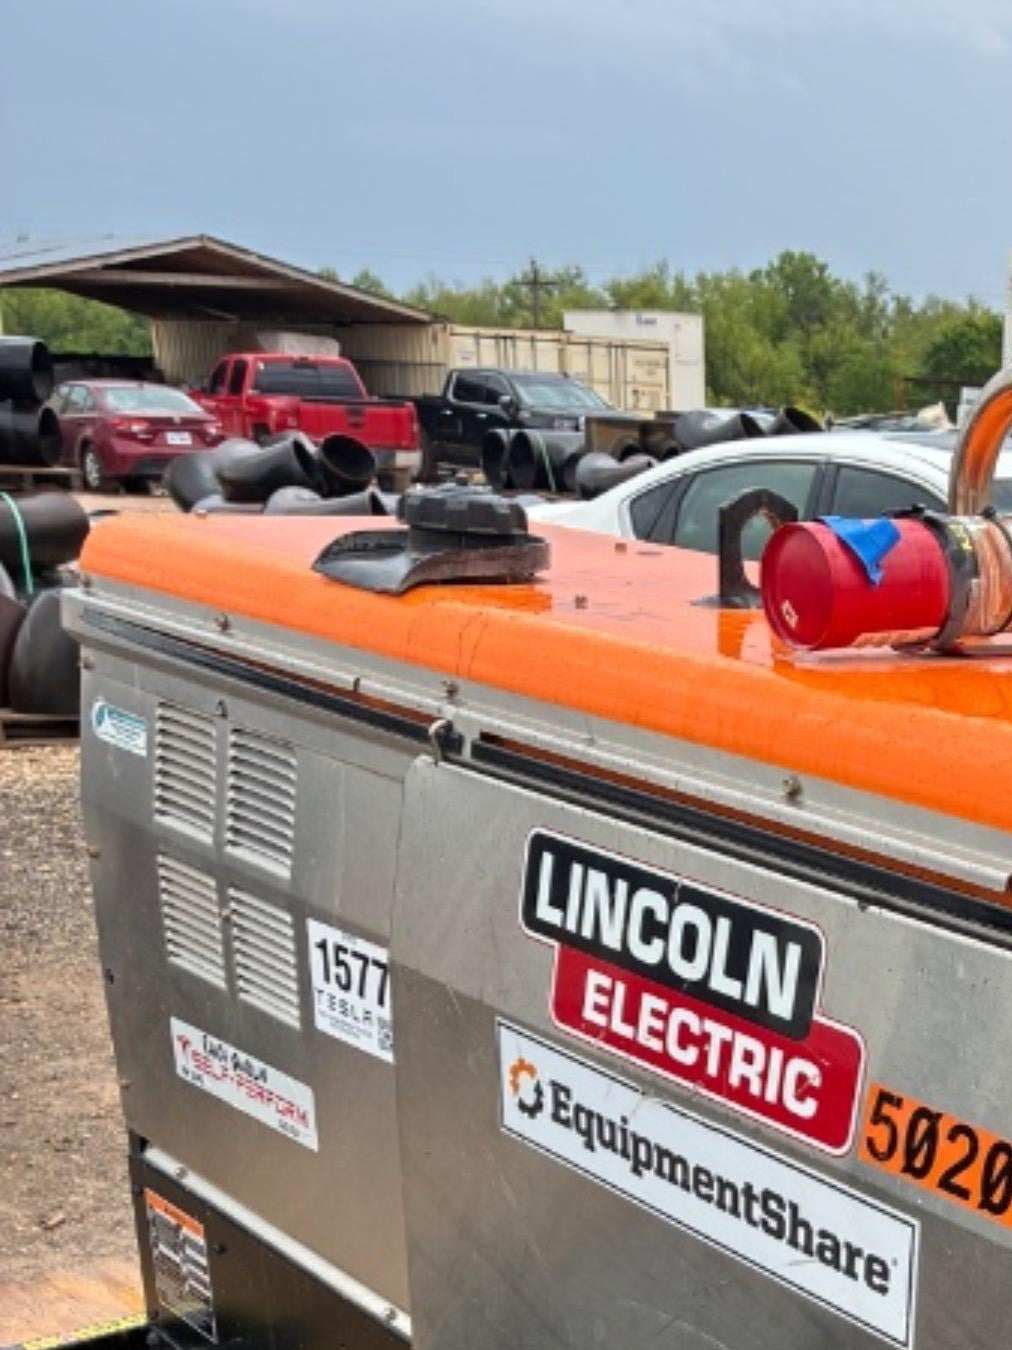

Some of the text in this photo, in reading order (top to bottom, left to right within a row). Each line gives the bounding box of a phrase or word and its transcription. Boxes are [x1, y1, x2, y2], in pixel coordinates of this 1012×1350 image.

[314, 938, 388, 1008] 1577
[315, 989, 373, 1025] TESLA
[534, 850, 802, 1022] LINCOLN
[581, 968, 823, 1121] ELECTRIC
[548, 1080, 891, 1295] EquipmentShare
